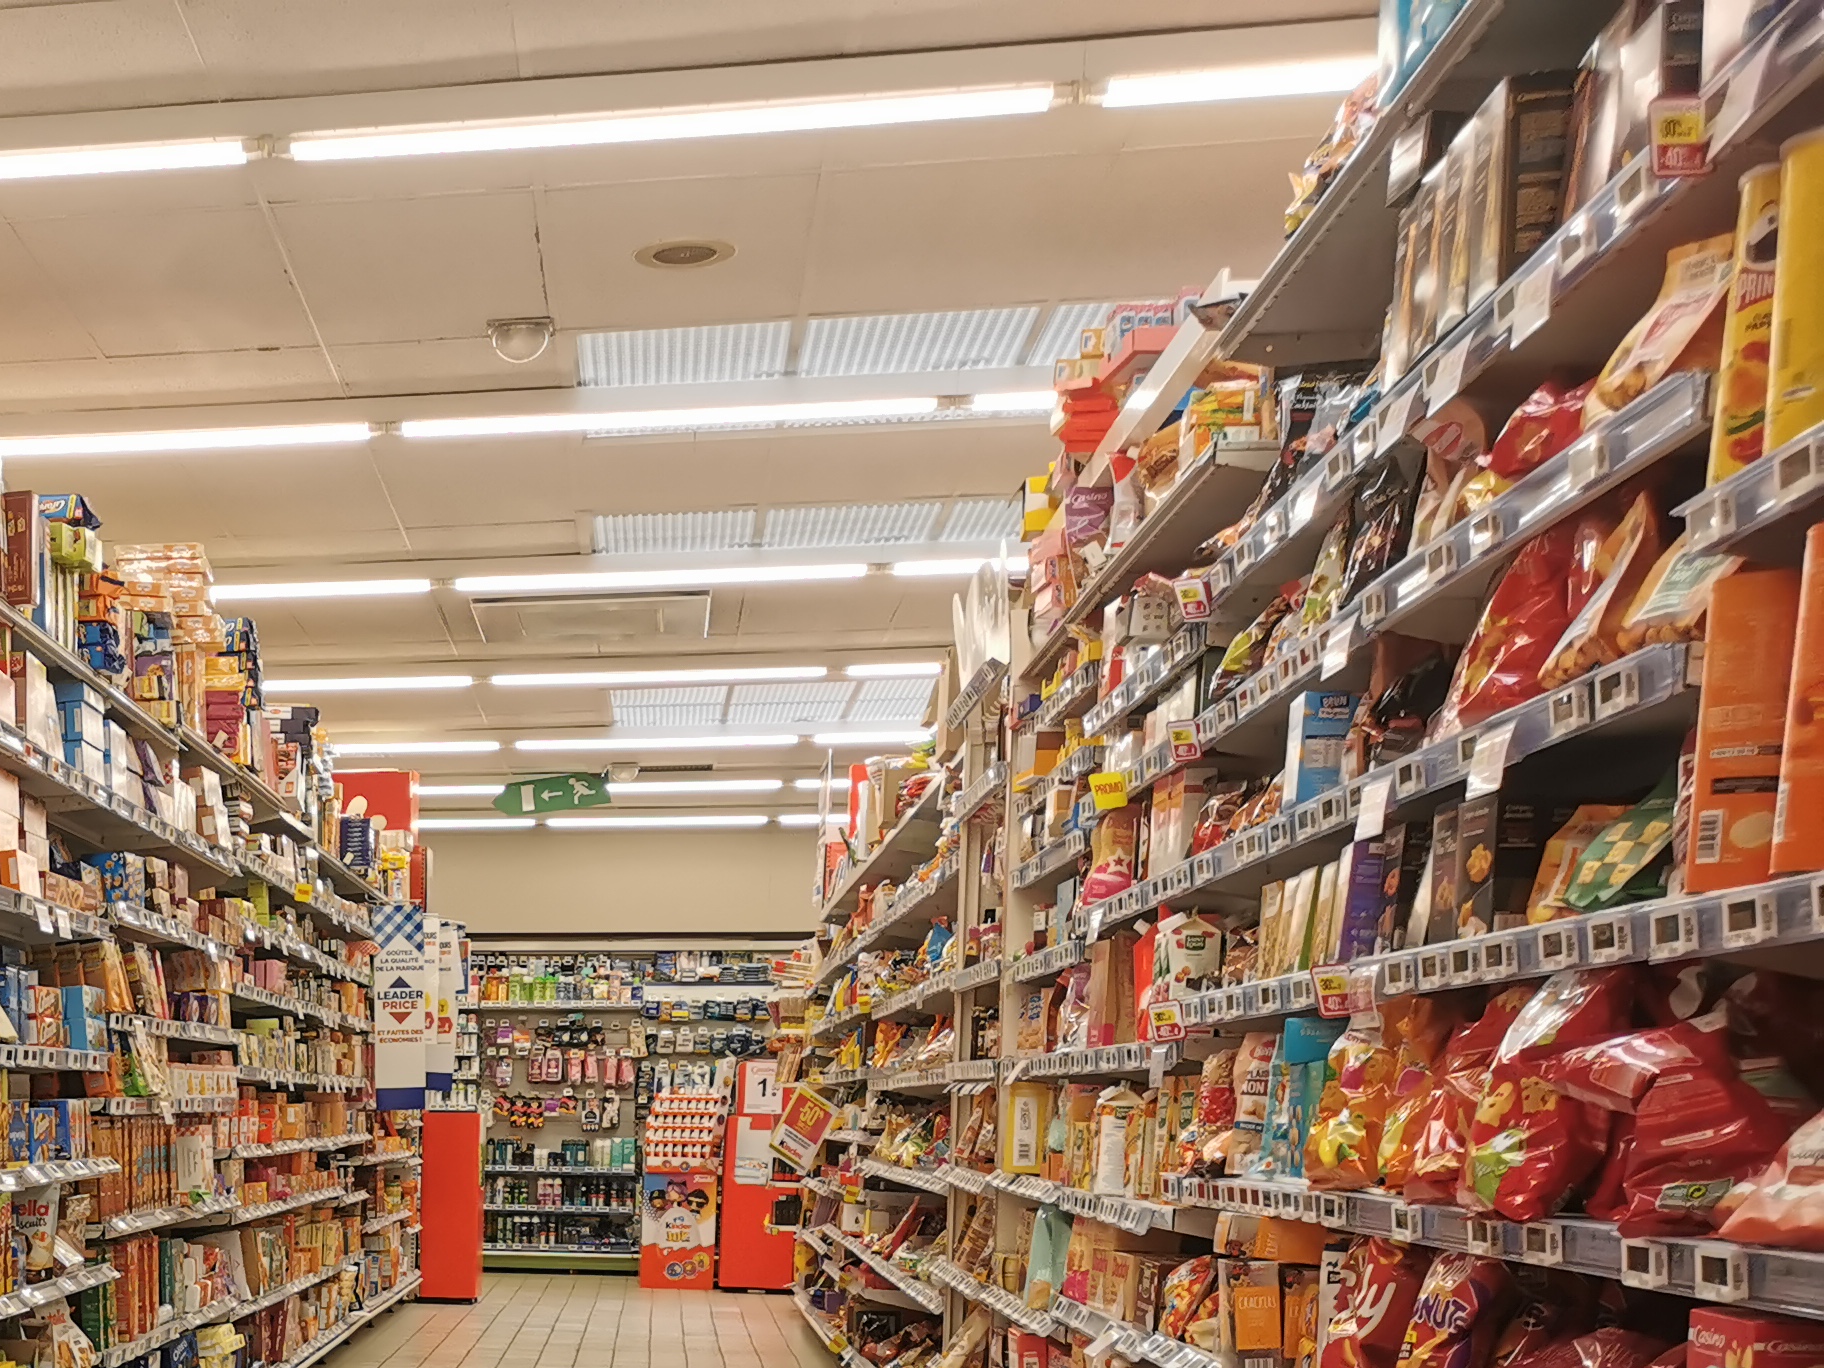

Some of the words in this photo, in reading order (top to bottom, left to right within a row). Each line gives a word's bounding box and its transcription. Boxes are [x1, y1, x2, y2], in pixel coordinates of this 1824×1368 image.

[1095, 780, 1123, 798] PROMO
[386, 948, 413, 956] GOÛTEZ
[390, 957, 419, 965] QUALITÉ
[395, 964, 424, 972] MARQUE
[377, 991, 423, 1000] LEADER
[382, 1001, 418, 1010] PRICE
[379, 1036, 418, 1044] ÉCONOMIES
[1693, 1326, 1725, 1348] Casino
